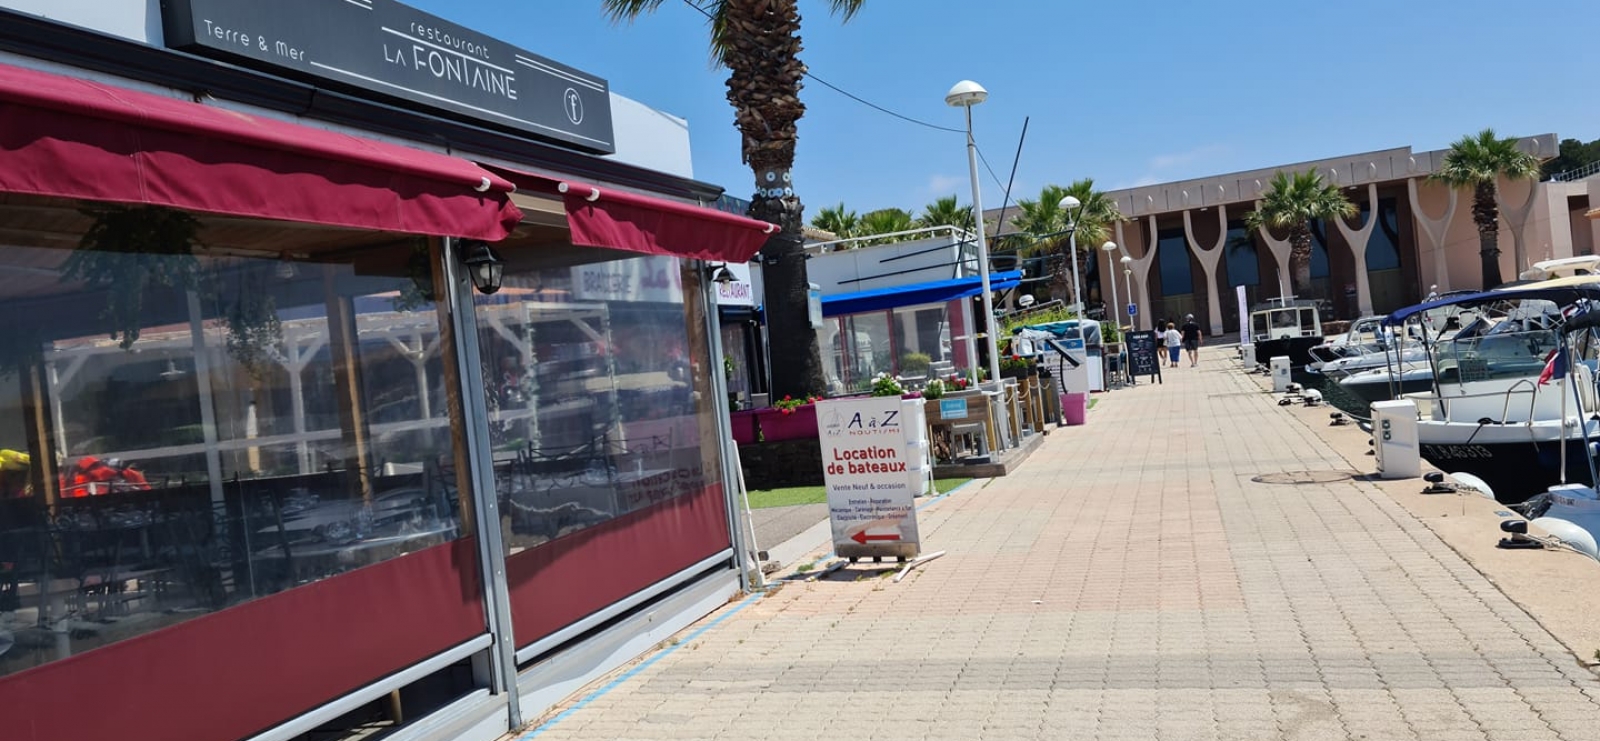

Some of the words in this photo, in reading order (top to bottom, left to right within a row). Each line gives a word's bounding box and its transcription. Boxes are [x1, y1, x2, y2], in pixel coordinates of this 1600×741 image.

[204, 19, 250, 46] Terre
[258, 35, 269, 52] &
[275, 40, 304, 61] Mer
[410, 21, 490, 59] restaurant
[383, 43, 407, 67] LA
[412, 44, 518, 101] FONTAINE
[847, 411, 862, 429] A
[880, 410, 899, 427] Z
[833, 445, 896, 461] Location
[827, 461, 844, 475] de
[848, 461, 907, 475] bateaux
[852, 483, 868, 491] Neuf
[877, 482, 906, 490] occasion
